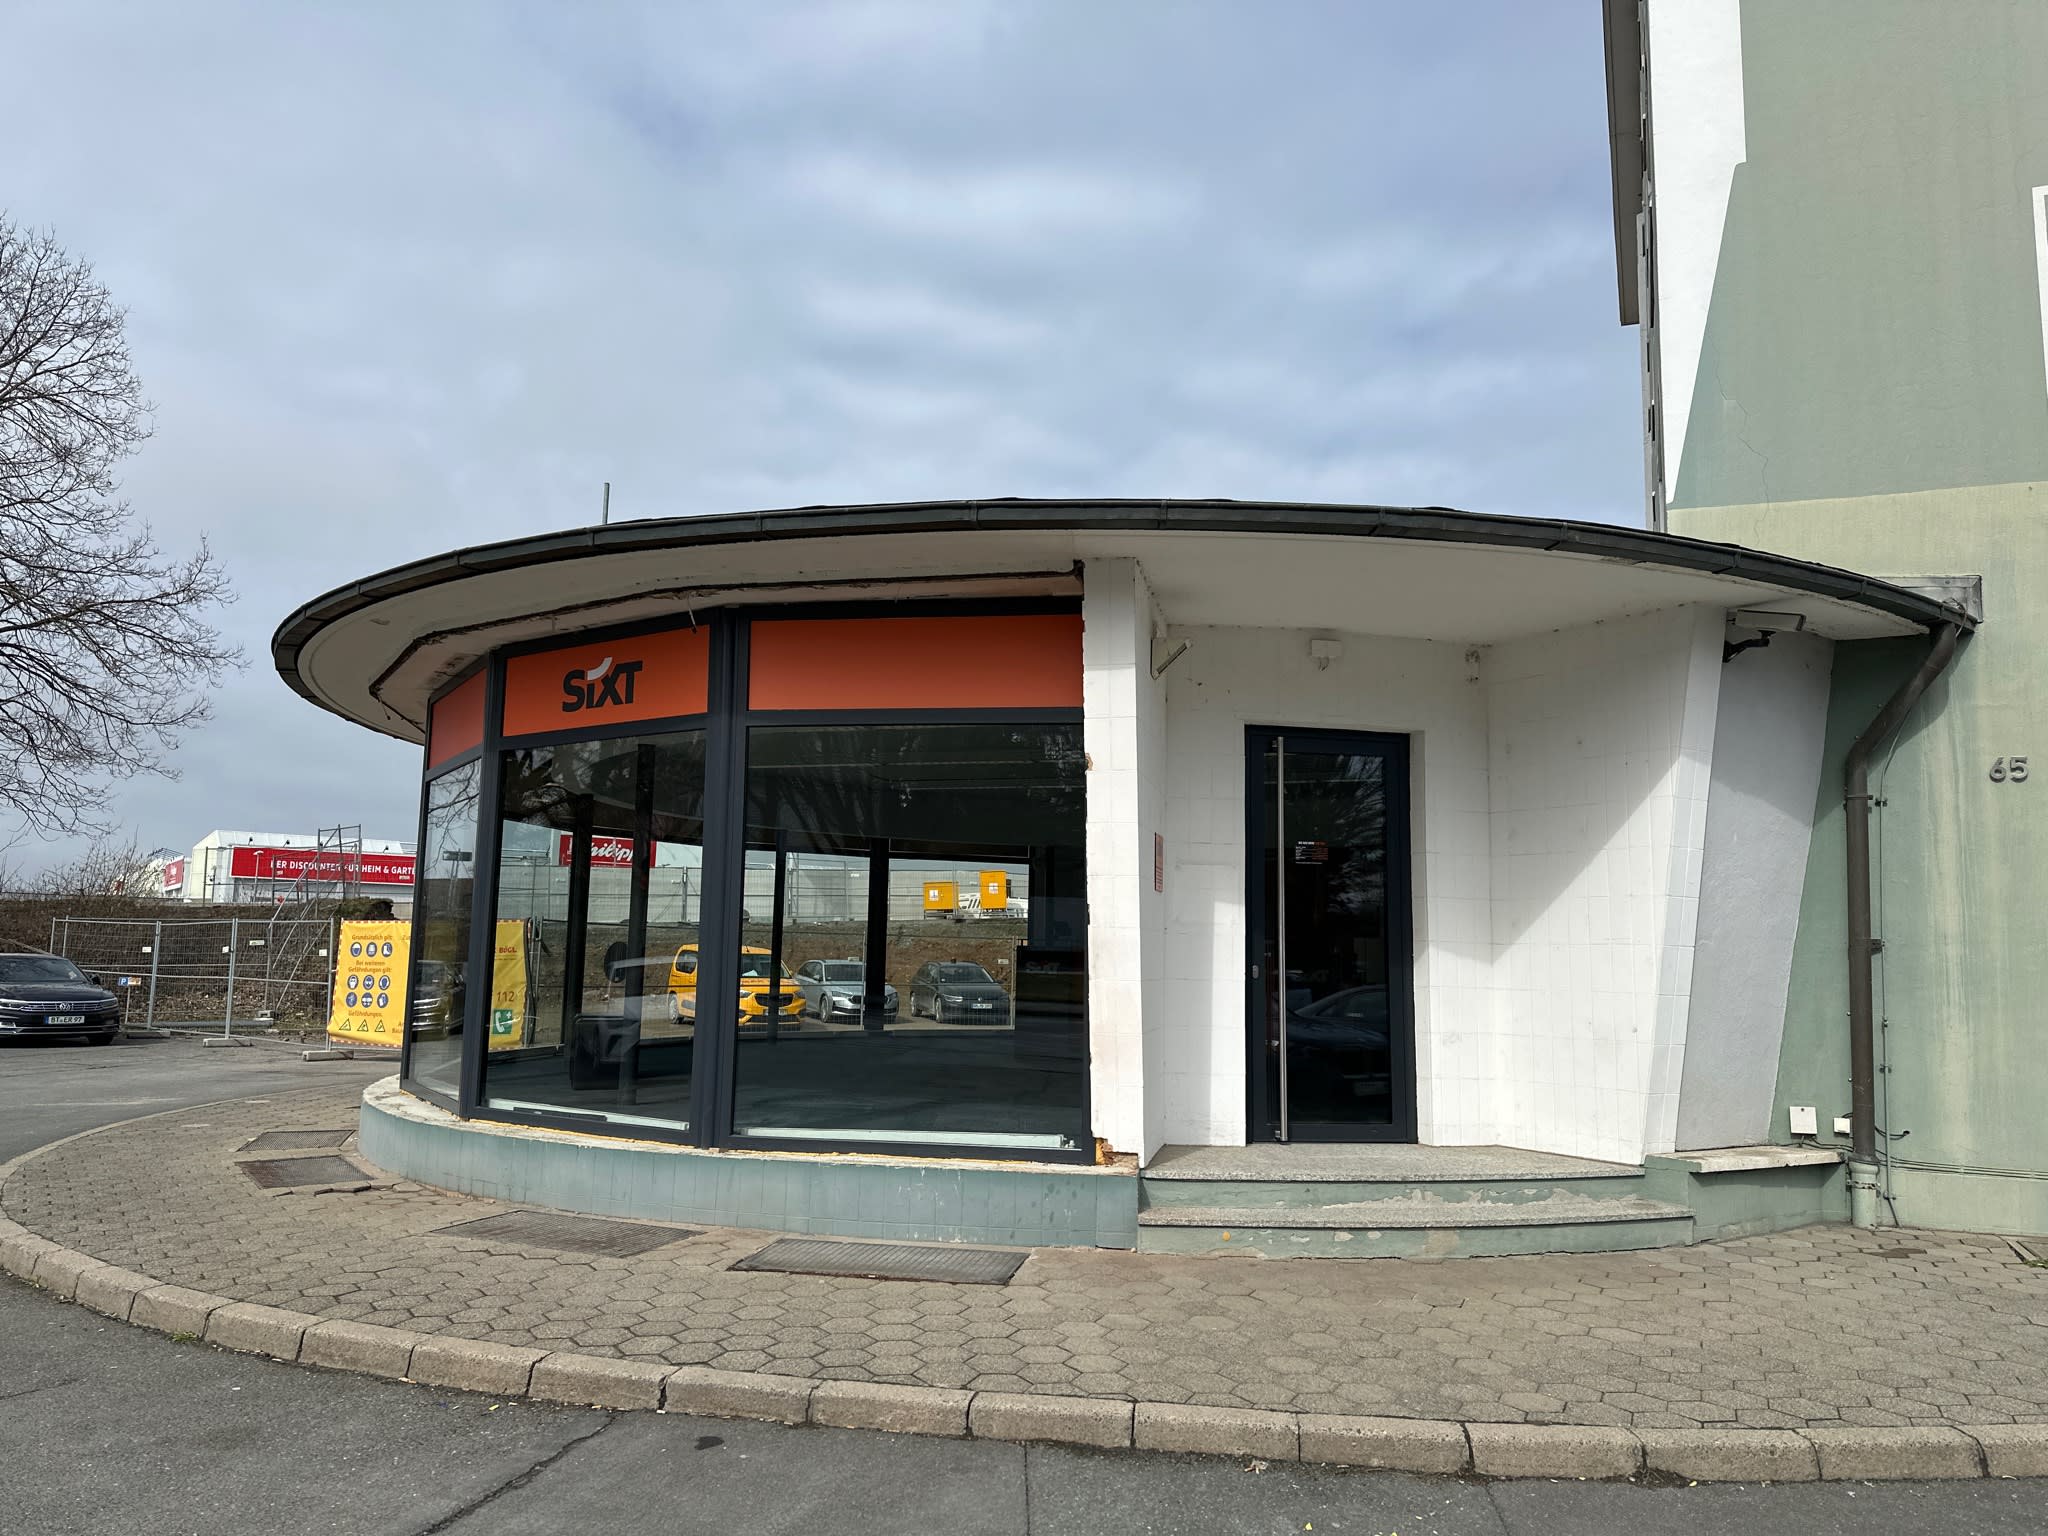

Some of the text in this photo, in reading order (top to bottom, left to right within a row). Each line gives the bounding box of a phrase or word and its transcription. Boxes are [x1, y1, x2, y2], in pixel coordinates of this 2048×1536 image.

[1989, 756, 2029, 784] 65
[361, 864, 381, 873] HEIM
[383, 865, 389, 874] &
[497, 991, 515, 1002] 112
